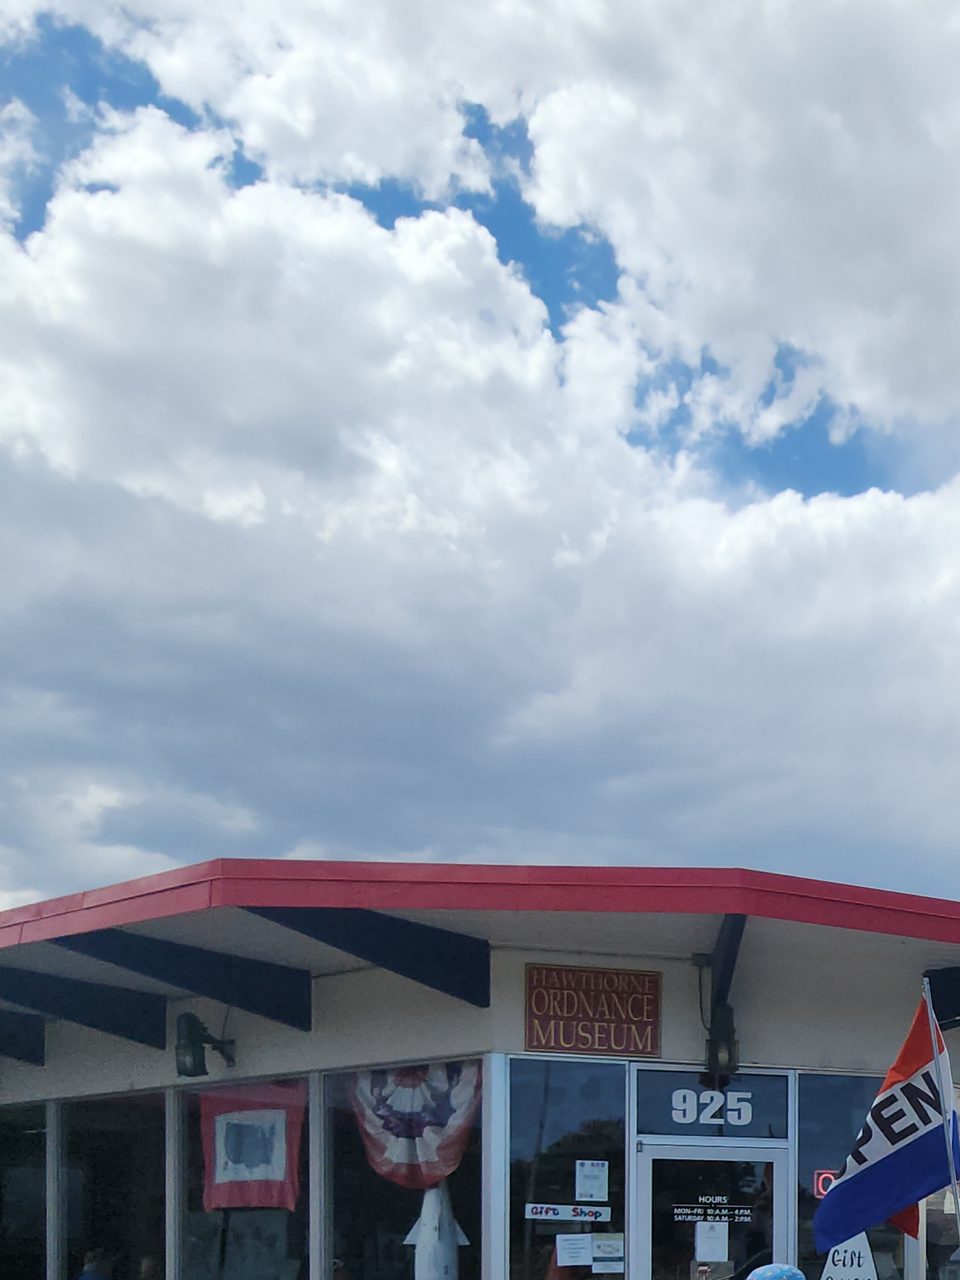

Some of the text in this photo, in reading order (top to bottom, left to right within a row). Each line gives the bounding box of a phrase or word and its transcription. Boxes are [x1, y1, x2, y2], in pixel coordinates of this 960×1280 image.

[531, 969, 654, 993] HAWTHORNE
[531, 988, 654, 1021] ORDNANCE
[531, 1018, 653, 1052] MUSEUM
[671, 1088, 753, 1126] 925
[571, 1206, 603, 1220] Shop
[832, 1249, 864, 1268] Gift
